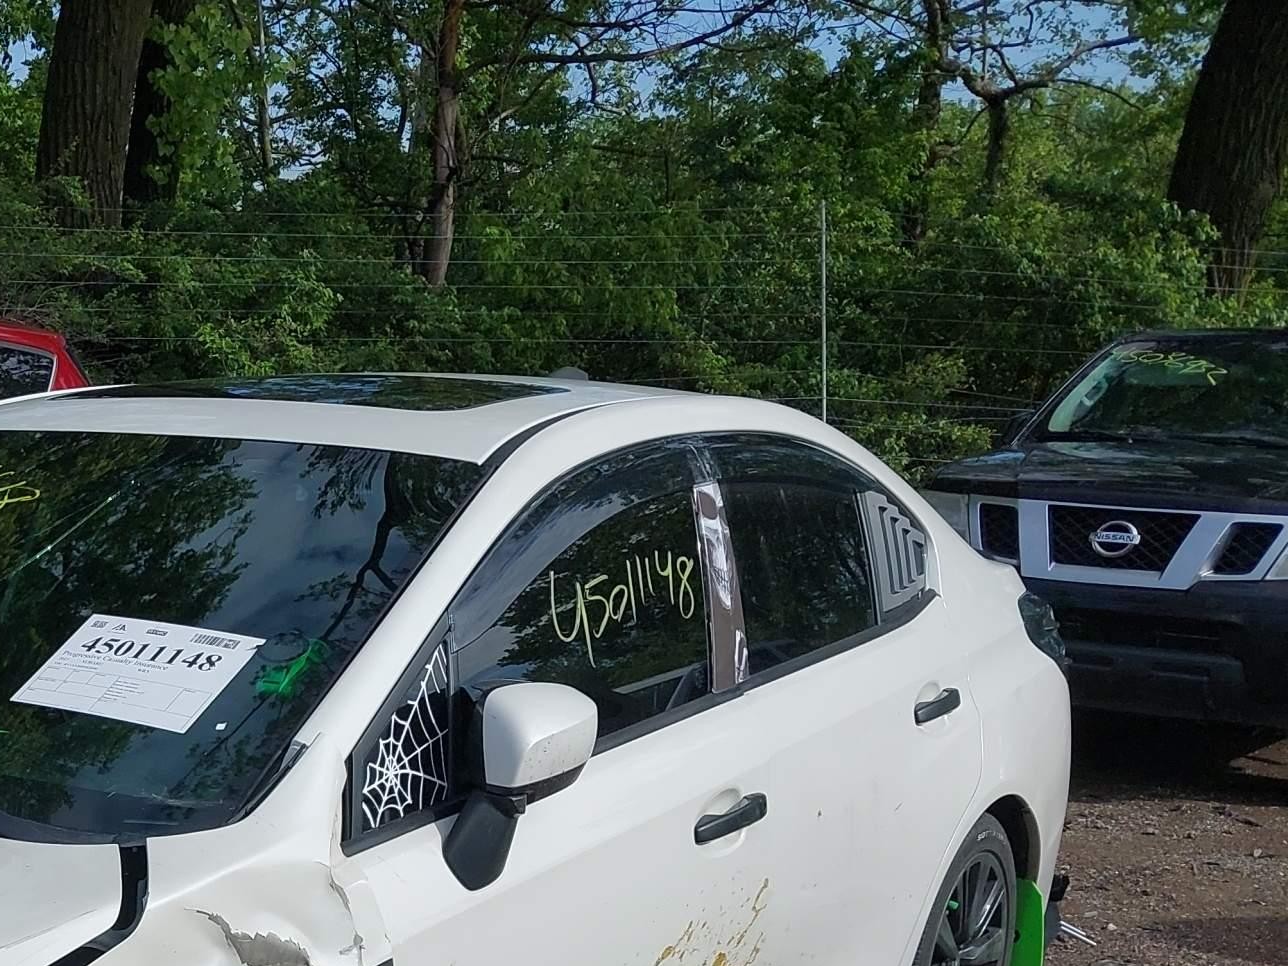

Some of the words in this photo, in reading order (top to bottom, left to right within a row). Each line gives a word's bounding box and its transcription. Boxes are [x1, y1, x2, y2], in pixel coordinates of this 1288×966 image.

[1095, 532, 1135, 542] NISSAN
[550, 550, 695, 668] 45011148
[62, 650, 103, 661] Progressive
[80, 635, 223, 673] 45011148
